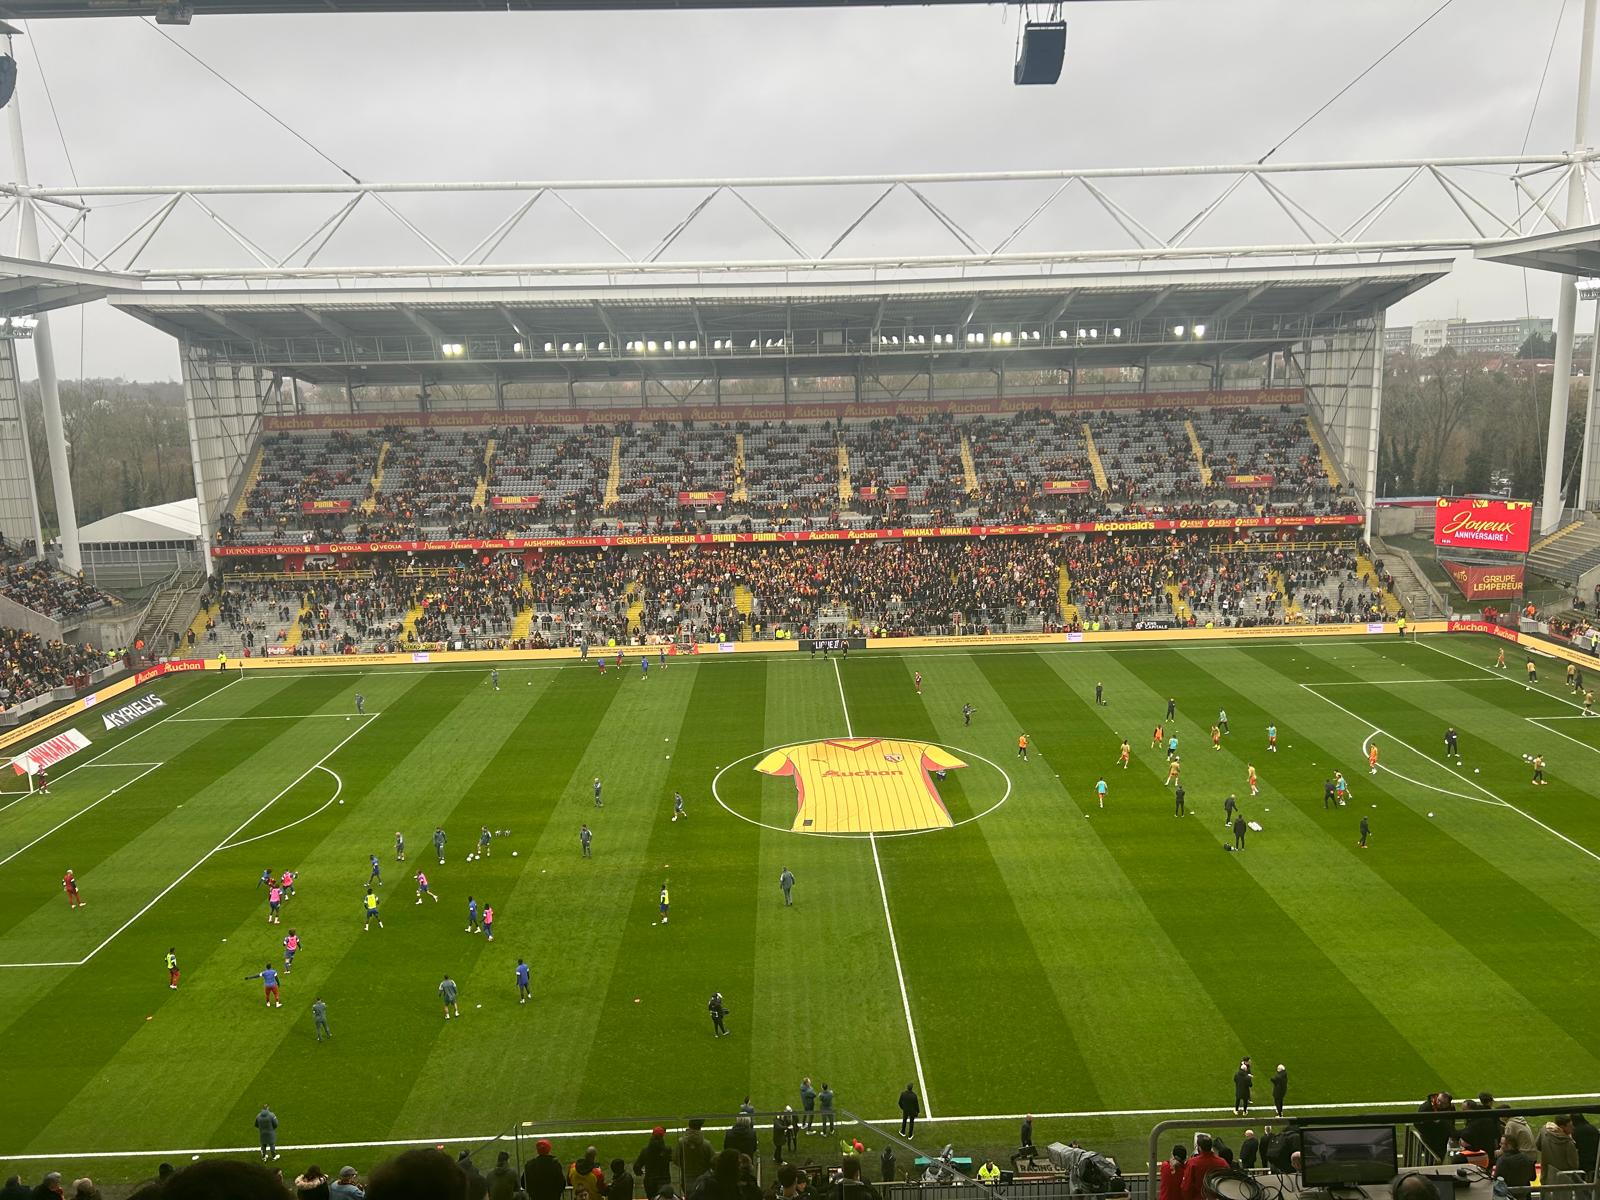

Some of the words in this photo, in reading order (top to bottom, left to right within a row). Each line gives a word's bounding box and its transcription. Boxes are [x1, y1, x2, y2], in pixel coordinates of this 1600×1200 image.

[270, 417, 313, 428] Auchan
[322, 417, 367, 428] Auchan
[376, 416, 420, 426] Auchan
[428, 415, 472, 425] Auchan
[481, 414, 525, 424] Auchan
[534, 411, 579, 422] Auchan
[587, 410, 630, 421] Auchan
[639, 410, 682, 420] Auchan
[691, 409, 734, 420] Auchan
[742, 408, 785, 419] Auchan
[794, 406, 836, 417] Auchan
[845, 405, 887, 415] Auchan
[896, 404, 938, 414] Auchan
[947, 402, 990, 412] Auchan
[998, 400, 1041, 411] Auchan
[1051, 398, 1093, 409] Auchan
[1102, 396, 1145, 408] Auchan
[1153, 395, 1197, 406] Auchan
[1206, 393, 1248, 404] Auchan
[1257, 392, 1300, 402] Auchan
[1094, 521, 1154, 531] McDonald's
[1443, 511, 1514, 534] Joyeux
[649, 536, 695, 544] LEMPEREUR
[713, 534, 736, 542] PUMA
[809, 532, 839, 540] Auchan
[1454, 530, 1503, 541] ANNIVERSAIRE
[1474, 582, 1523, 591] LEMPEREUR
[1452, 622, 1489, 632] Auchan
[1493, 626, 1516, 641] Auchan
[164, 663, 200, 672] Auchan
[138, 669, 158, 683] Auchan
[107, 693, 163, 727] KYRIELYS
[27, 734, 80, 766] WINAMAX
[822, 769, 903, 777] Auchan
